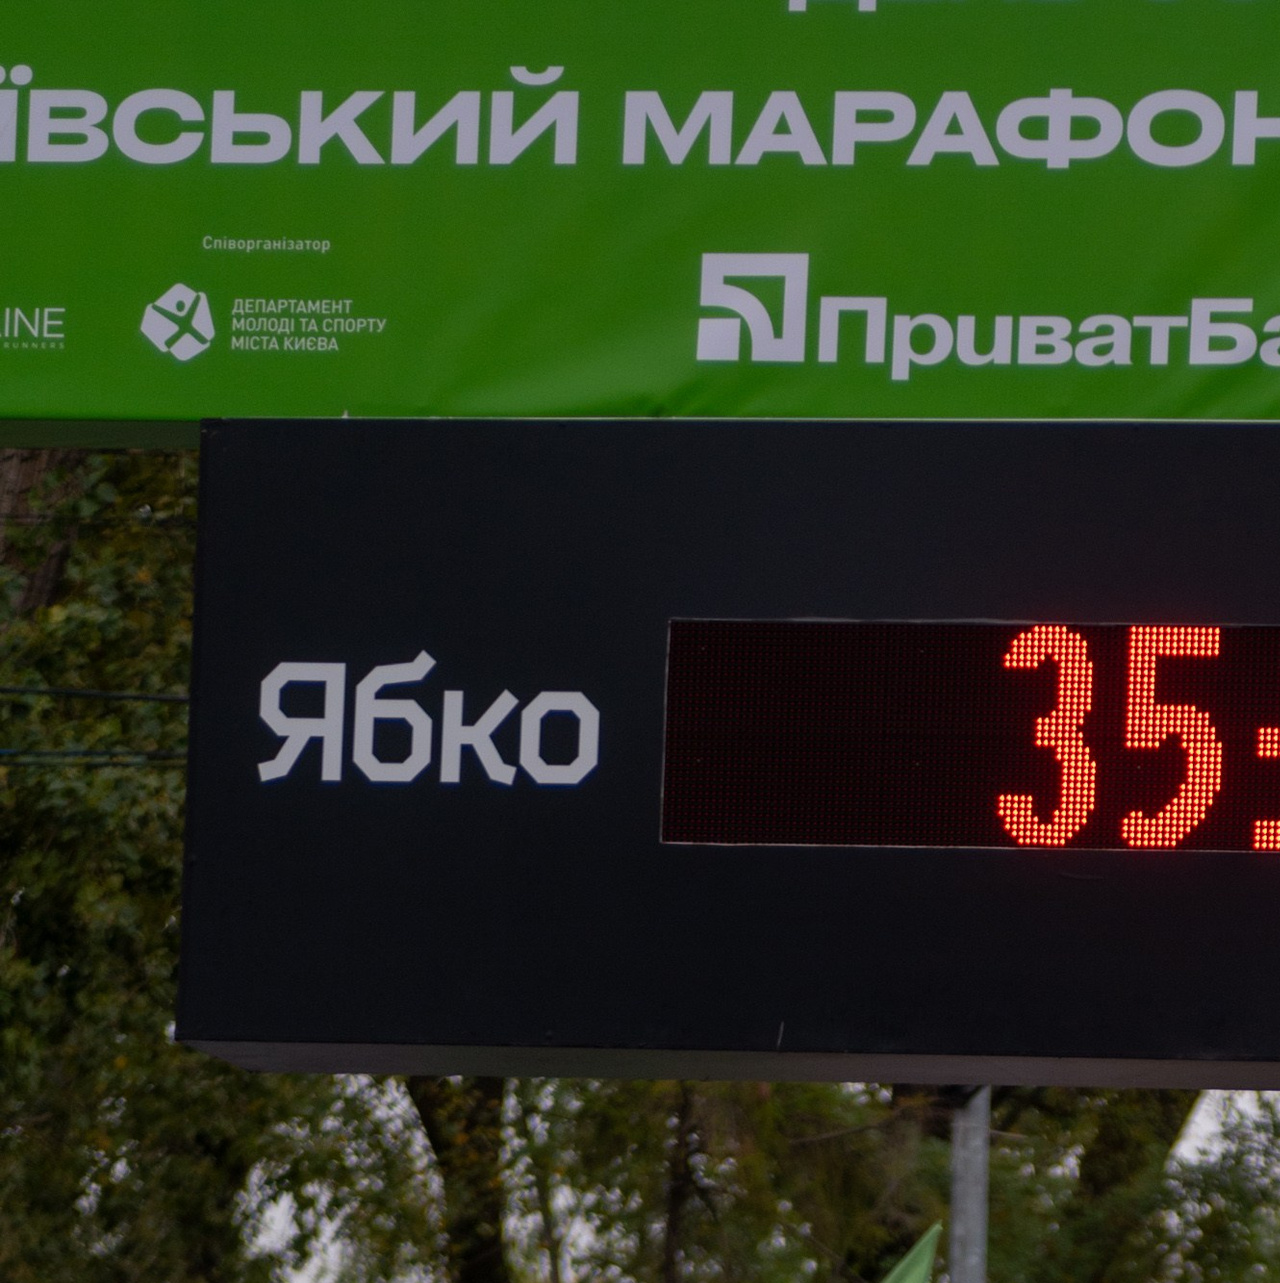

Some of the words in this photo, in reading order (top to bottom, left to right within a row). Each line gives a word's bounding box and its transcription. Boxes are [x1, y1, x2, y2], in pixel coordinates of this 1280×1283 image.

[202, 235, 332, 253] Співорганізатор
[231, 299, 353, 315] ДЕПАРТАМЕНТ
[0, 307, 66, 338] INE
[231, 317, 295, 334] МОЛОДІ
[299, 318, 318, 333] ТА
[322, 318, 387, 333] СПОРТУ
[3, 341, 66, 350] RUNNERS
[230, 335, 279, 351] МІСТА
[283, 336, 339, 351] КИЄВА
[257, 649, 600, 786] Ябко
